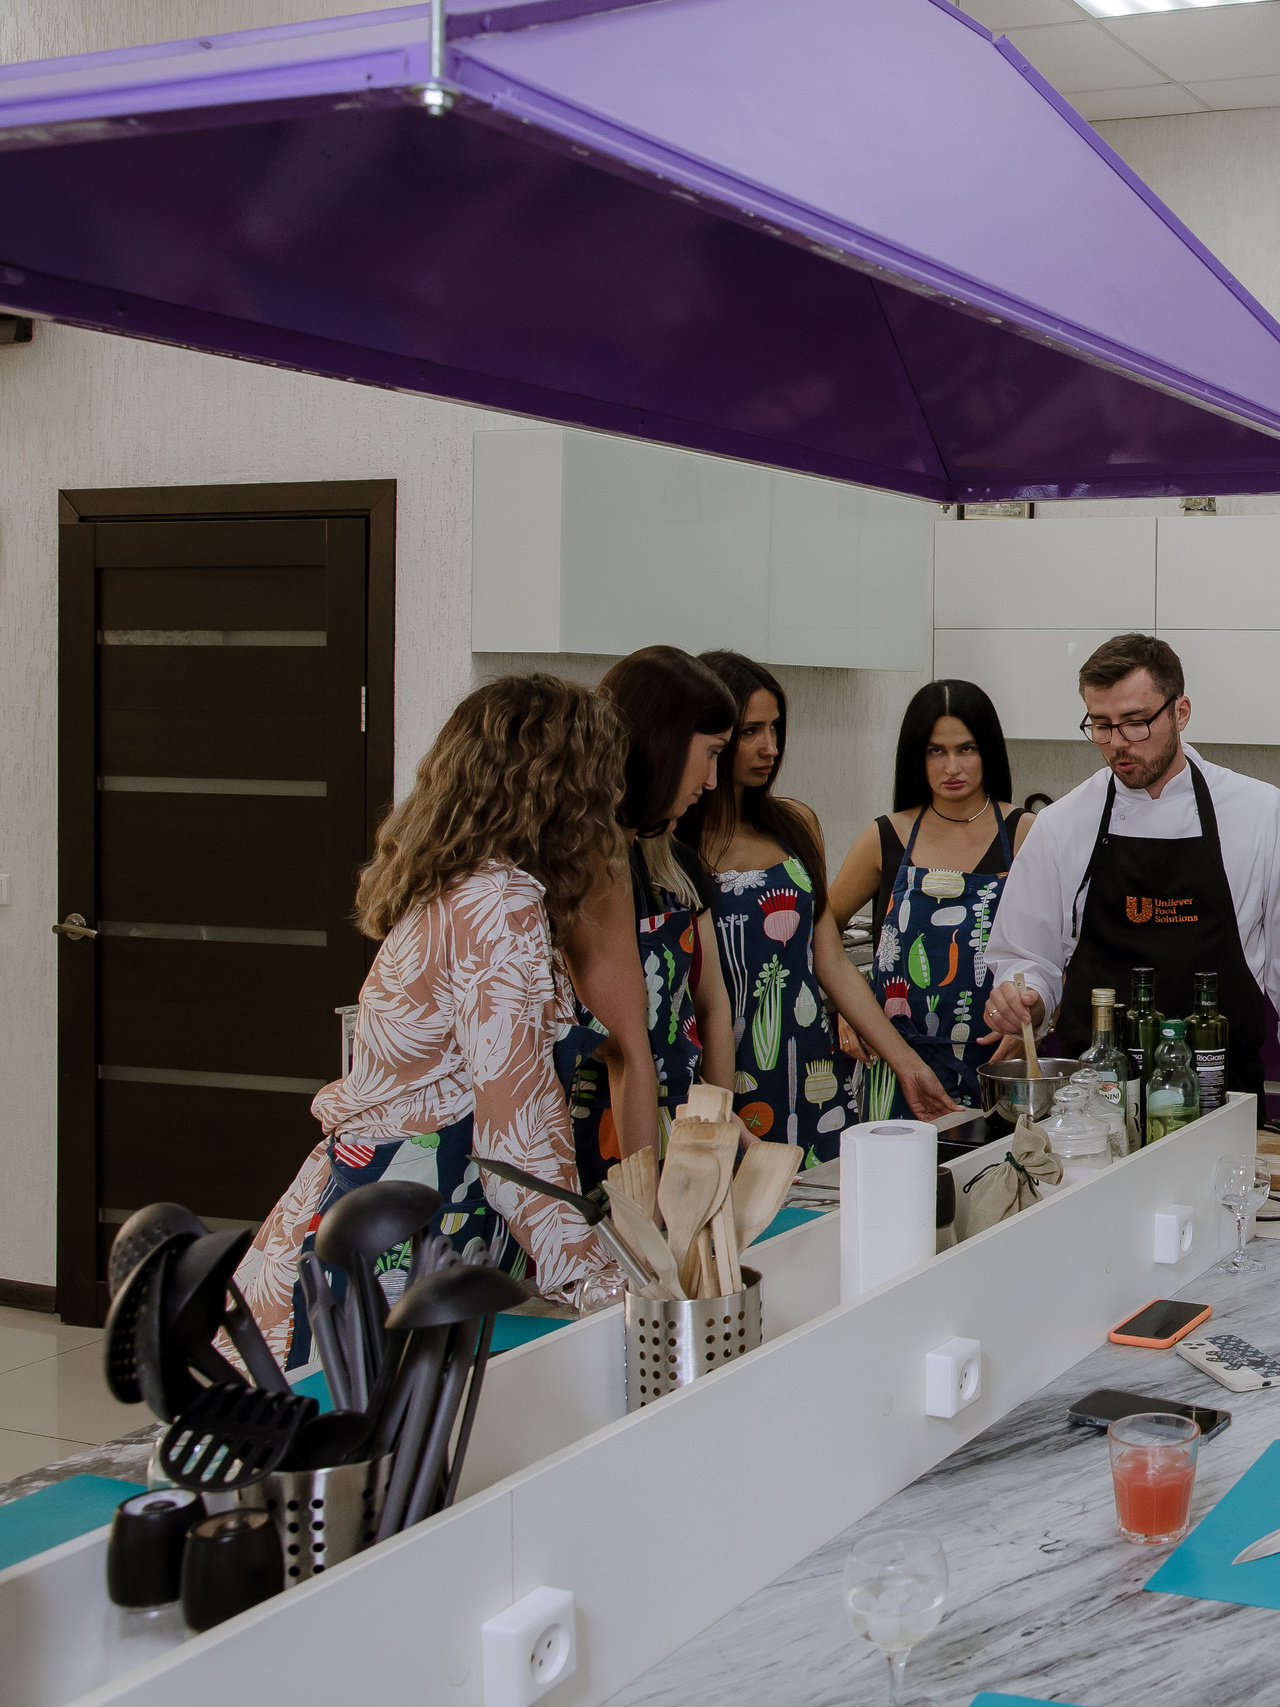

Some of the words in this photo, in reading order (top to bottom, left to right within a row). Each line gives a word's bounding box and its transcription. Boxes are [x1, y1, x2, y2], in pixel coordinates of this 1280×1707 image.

[1154, 898, 1194, 907] Unilever
[1154, 907, 1177, 915] Food
[1154, 914, 1199, 923] Solutions
